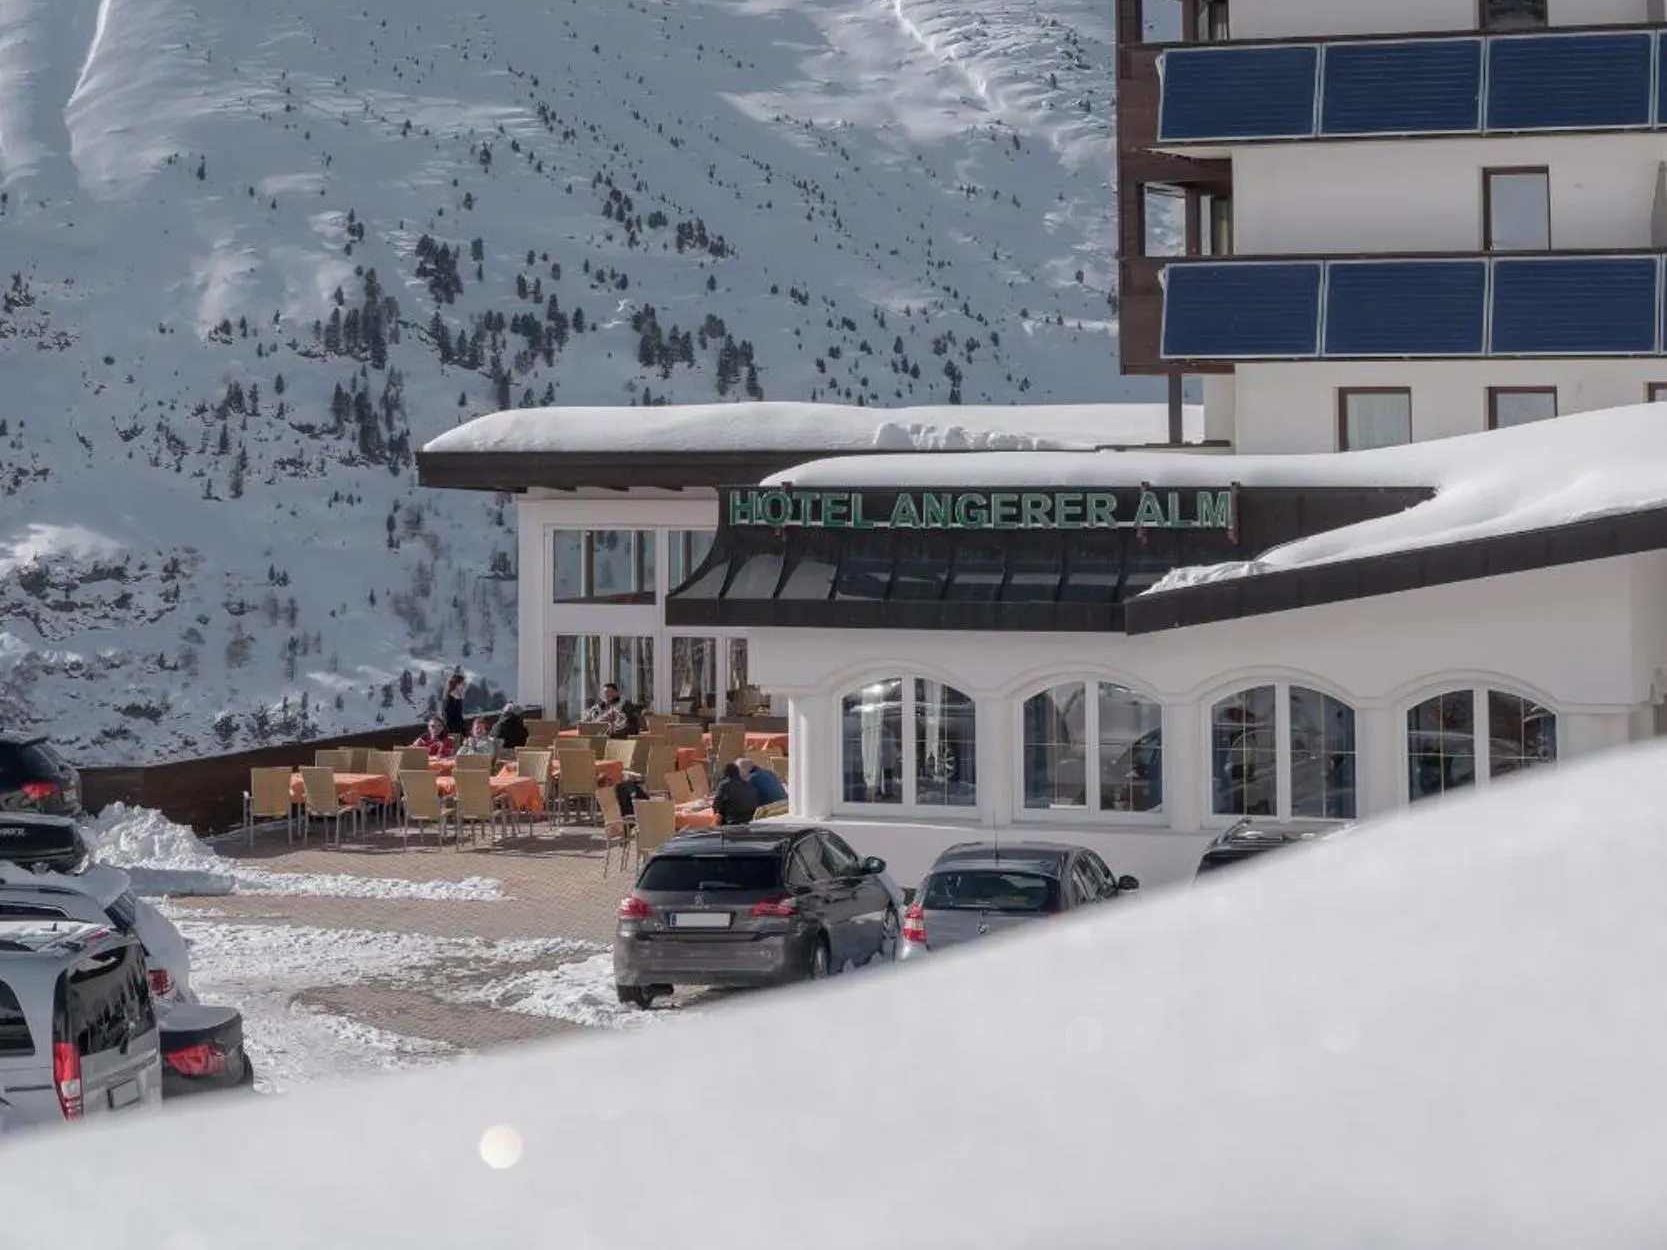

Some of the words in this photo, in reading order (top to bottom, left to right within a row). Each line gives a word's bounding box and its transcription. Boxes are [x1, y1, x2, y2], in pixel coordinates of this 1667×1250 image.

[729, 490, 874, 528] HOTEL
[889, 491, 1117, 529] ANGERER
[1134, 490, 1231, 528] ALM
